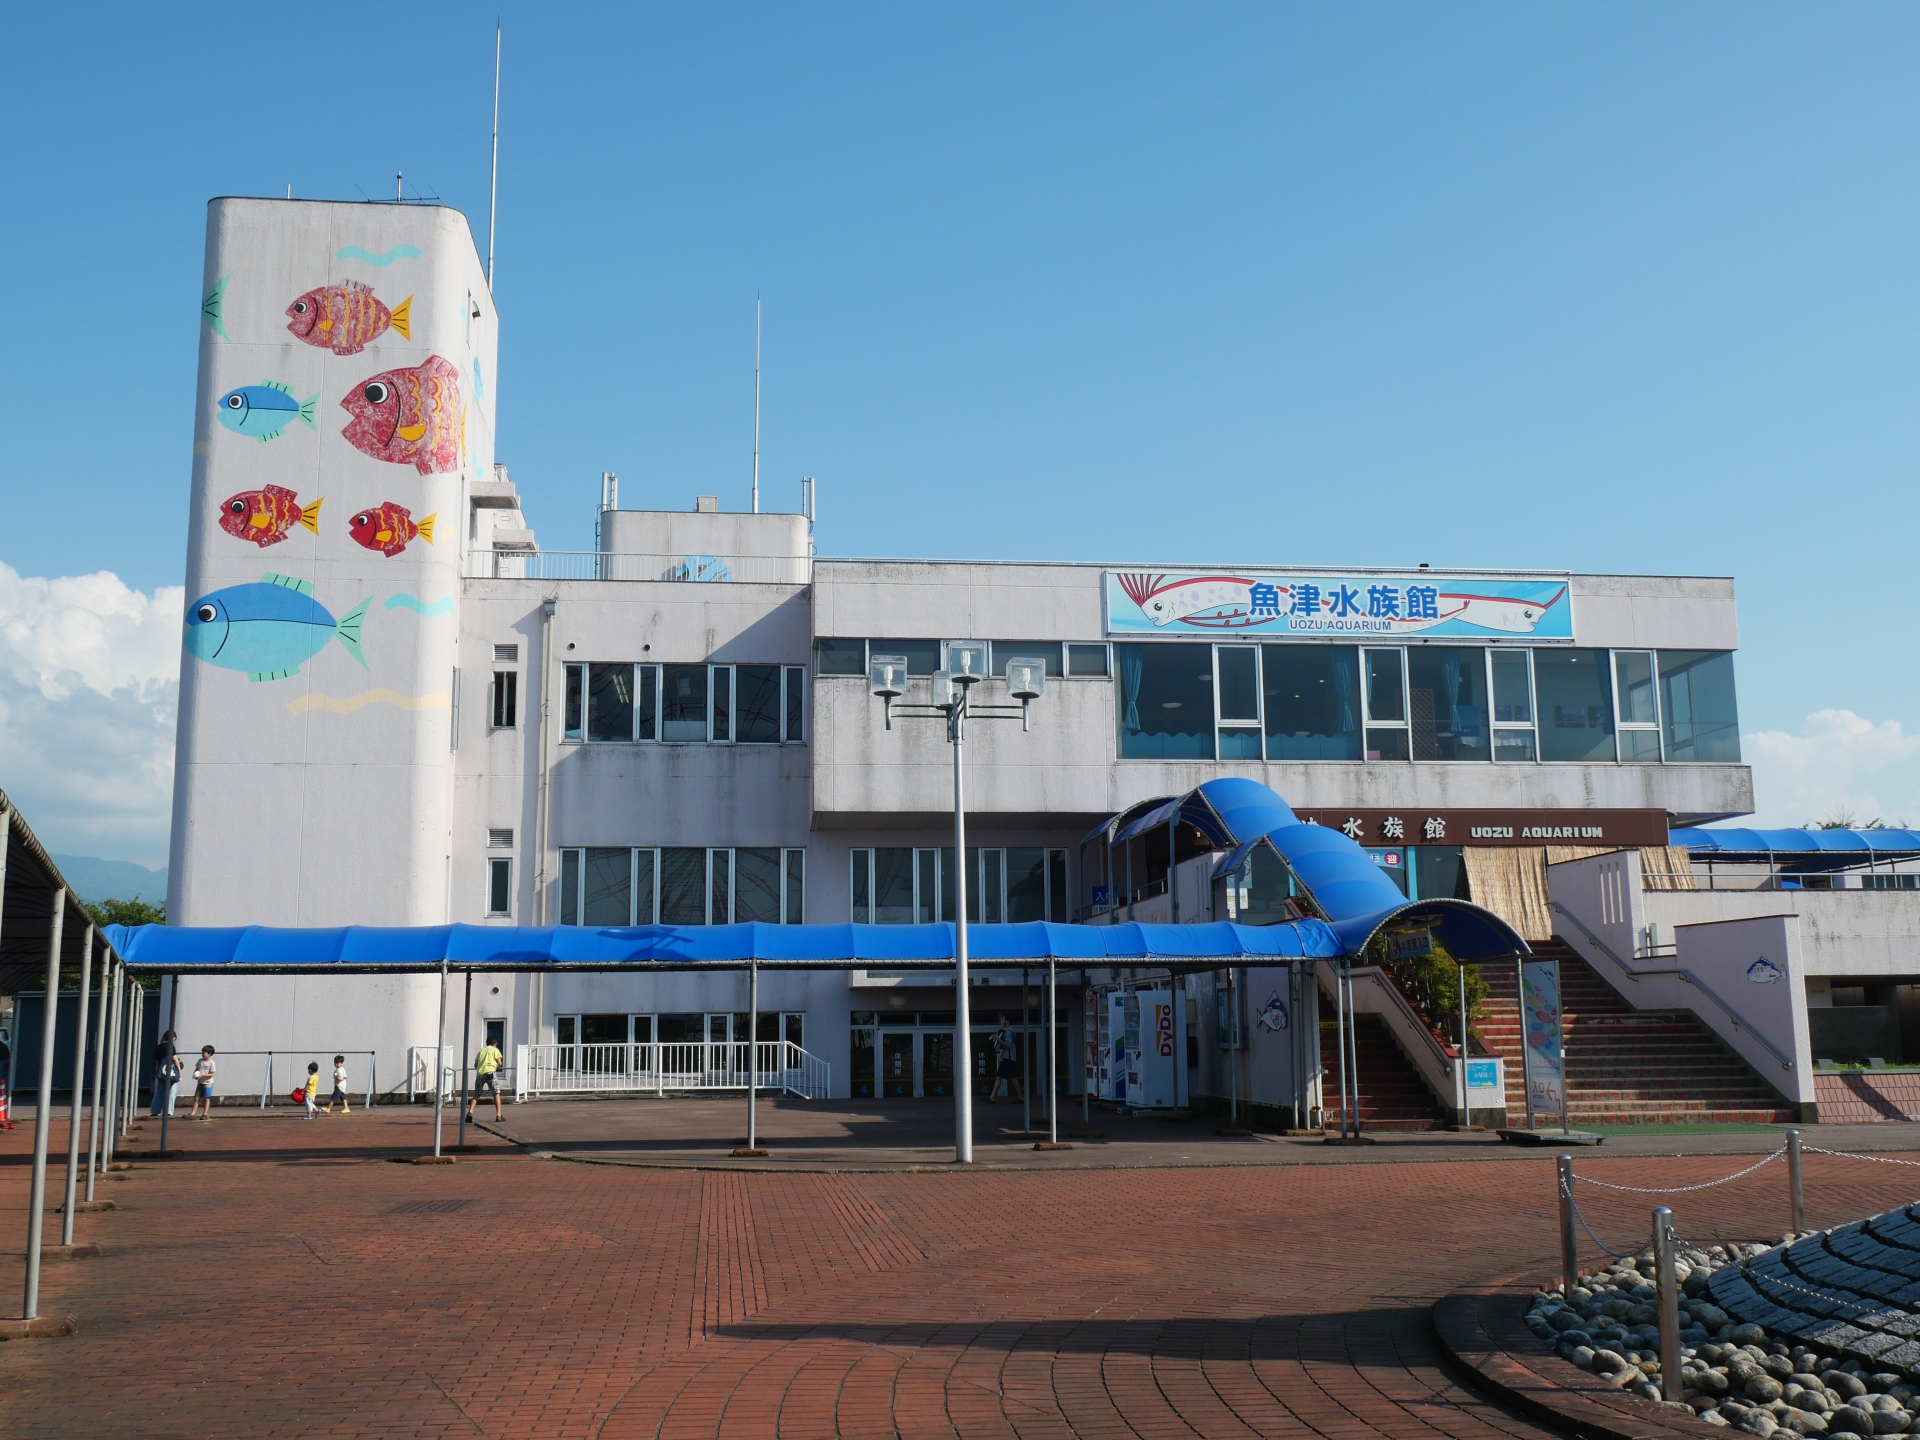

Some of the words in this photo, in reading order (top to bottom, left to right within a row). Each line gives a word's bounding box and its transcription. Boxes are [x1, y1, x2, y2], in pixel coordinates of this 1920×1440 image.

[1248, 582, 1439, 619] 魚津水族館
[1289, 620, 1323, 631] UOZU
[1327, 621, 1392, 632] AQUARIUM
[1301, 817, 1447, 839] 水族館
[1471, 826, 1514, 838] UOZU
[1522, 827, 1603, 838] AQUARIUM
[1532, 1081, 1545, 1093] 入口
